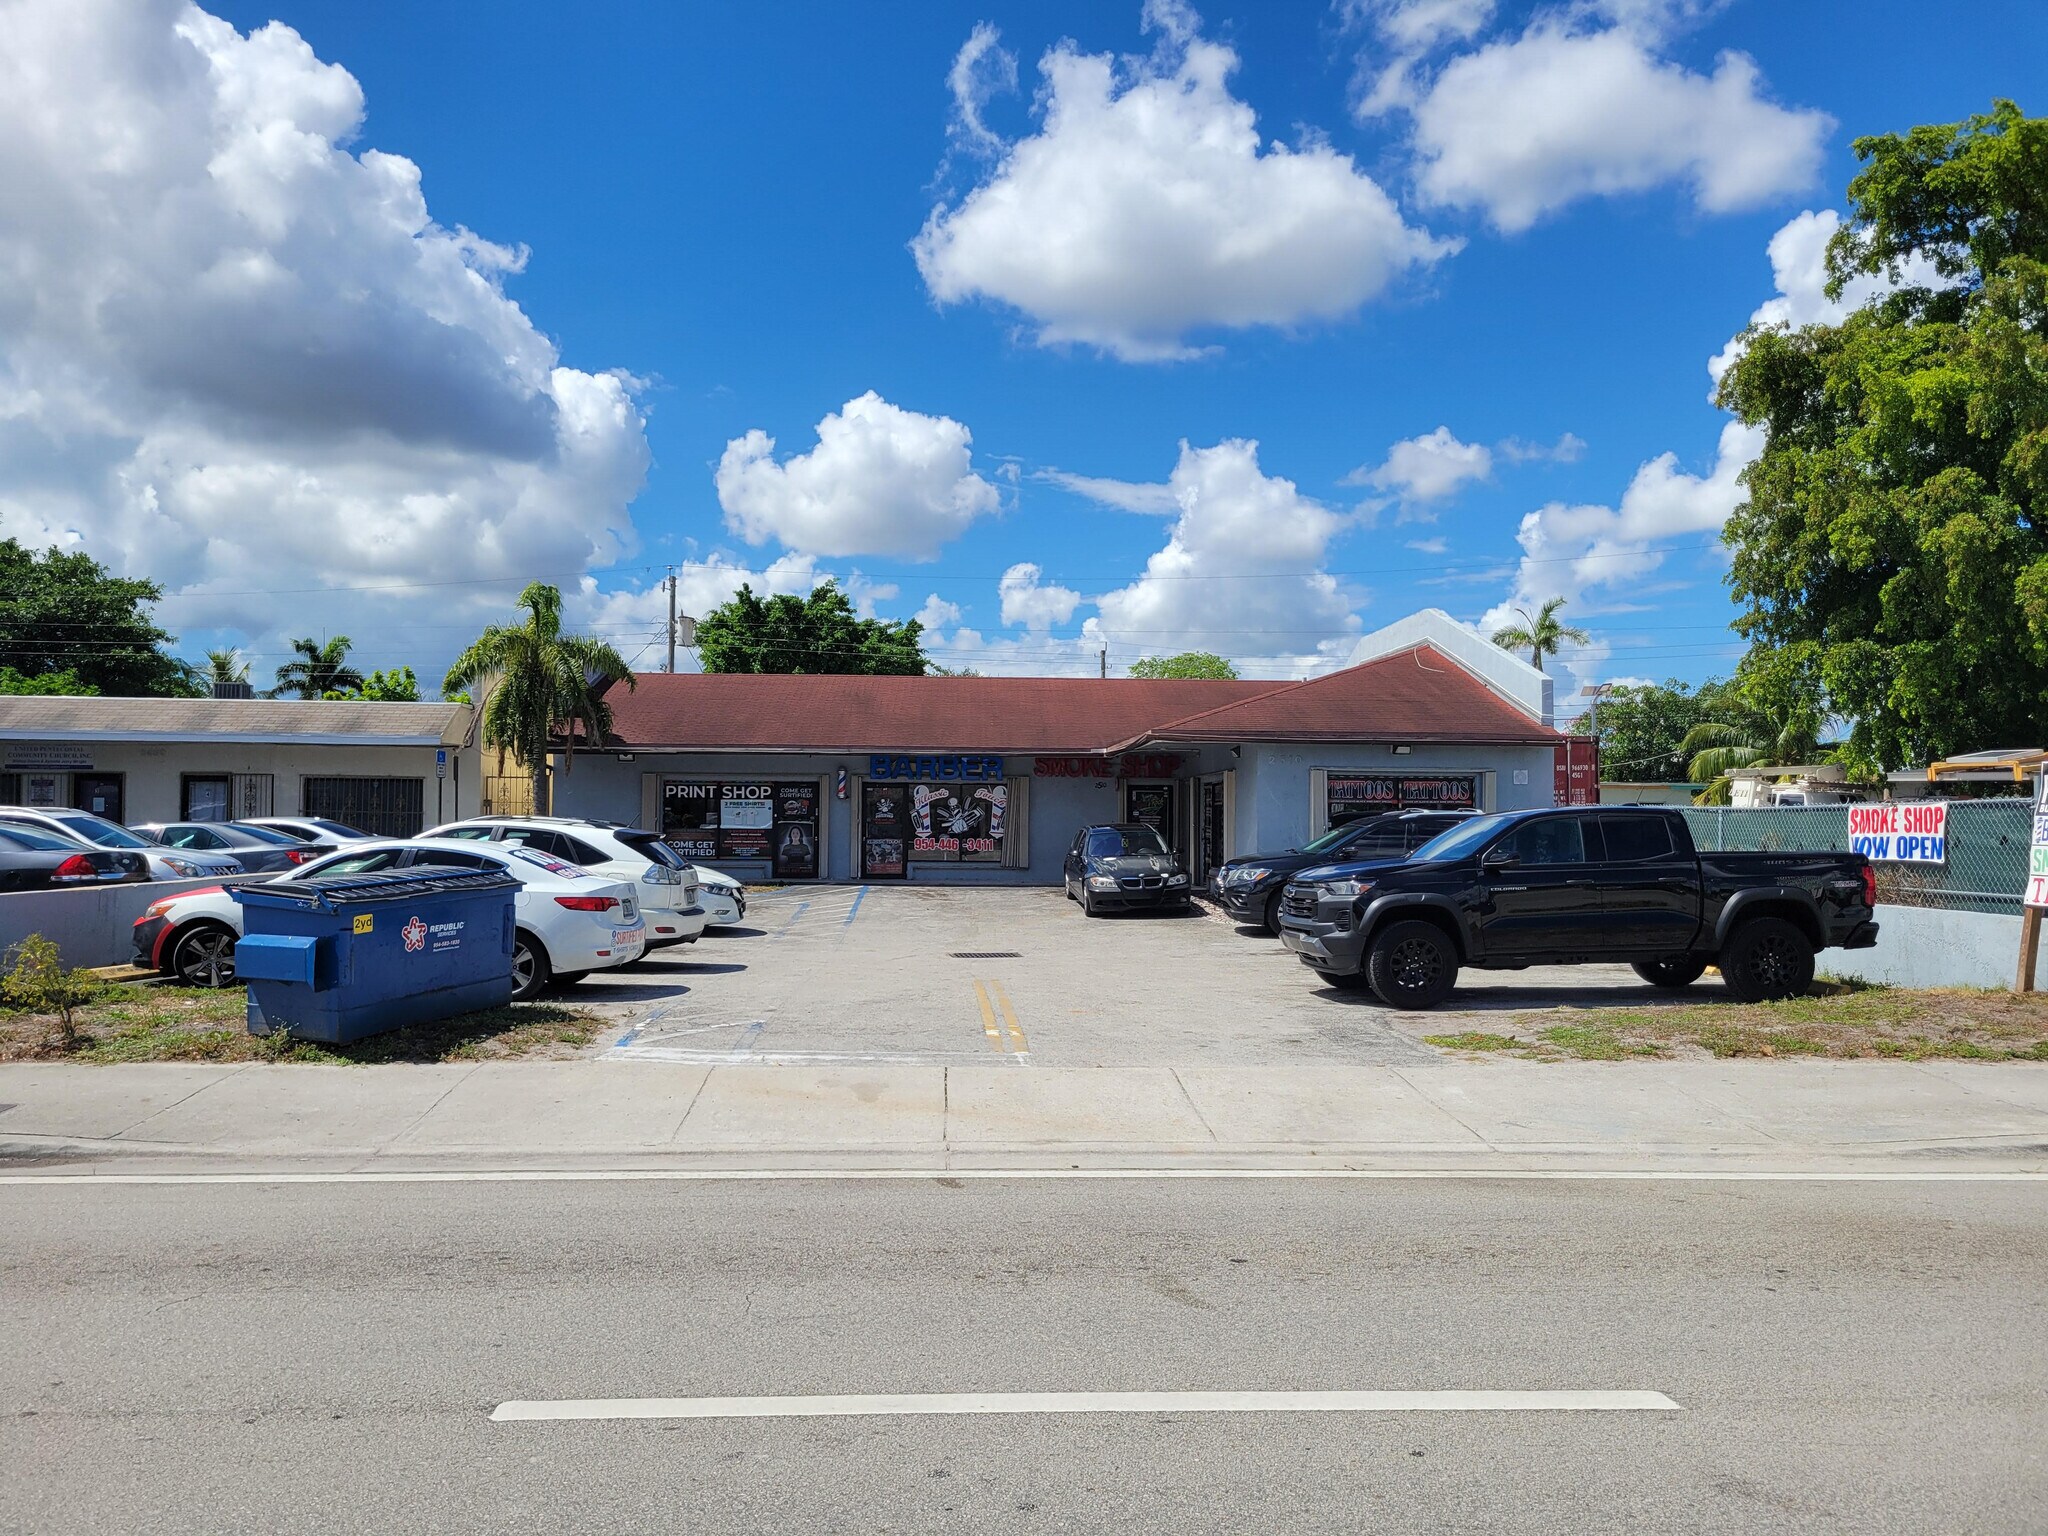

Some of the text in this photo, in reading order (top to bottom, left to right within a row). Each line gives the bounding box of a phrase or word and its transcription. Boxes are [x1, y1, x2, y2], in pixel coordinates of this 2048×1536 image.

[870, 755, 1004, 781] BARBER
[1033, 754, 1181, 778] SMOKE SHOP
[665, 785, 772, 799] PRINT SHOP
[1328, 780, 1394, 799] TATTOOS
[1403, 780, 1470, 799] TATTOOS
[1850, 806, 1944, 835] SMOKE SHOP
[667, 841, 694, 849] COME
[696, 841, 715, 849] GET
[676, 848, 716, 856] RTIFIED!
[914, 838, 960, 851] 954-446
[1896, 836, 1944, 860] OPEN
[354, 917, 372, 930] 2yd
[429, 921, 465, 933] REPUBLIC
